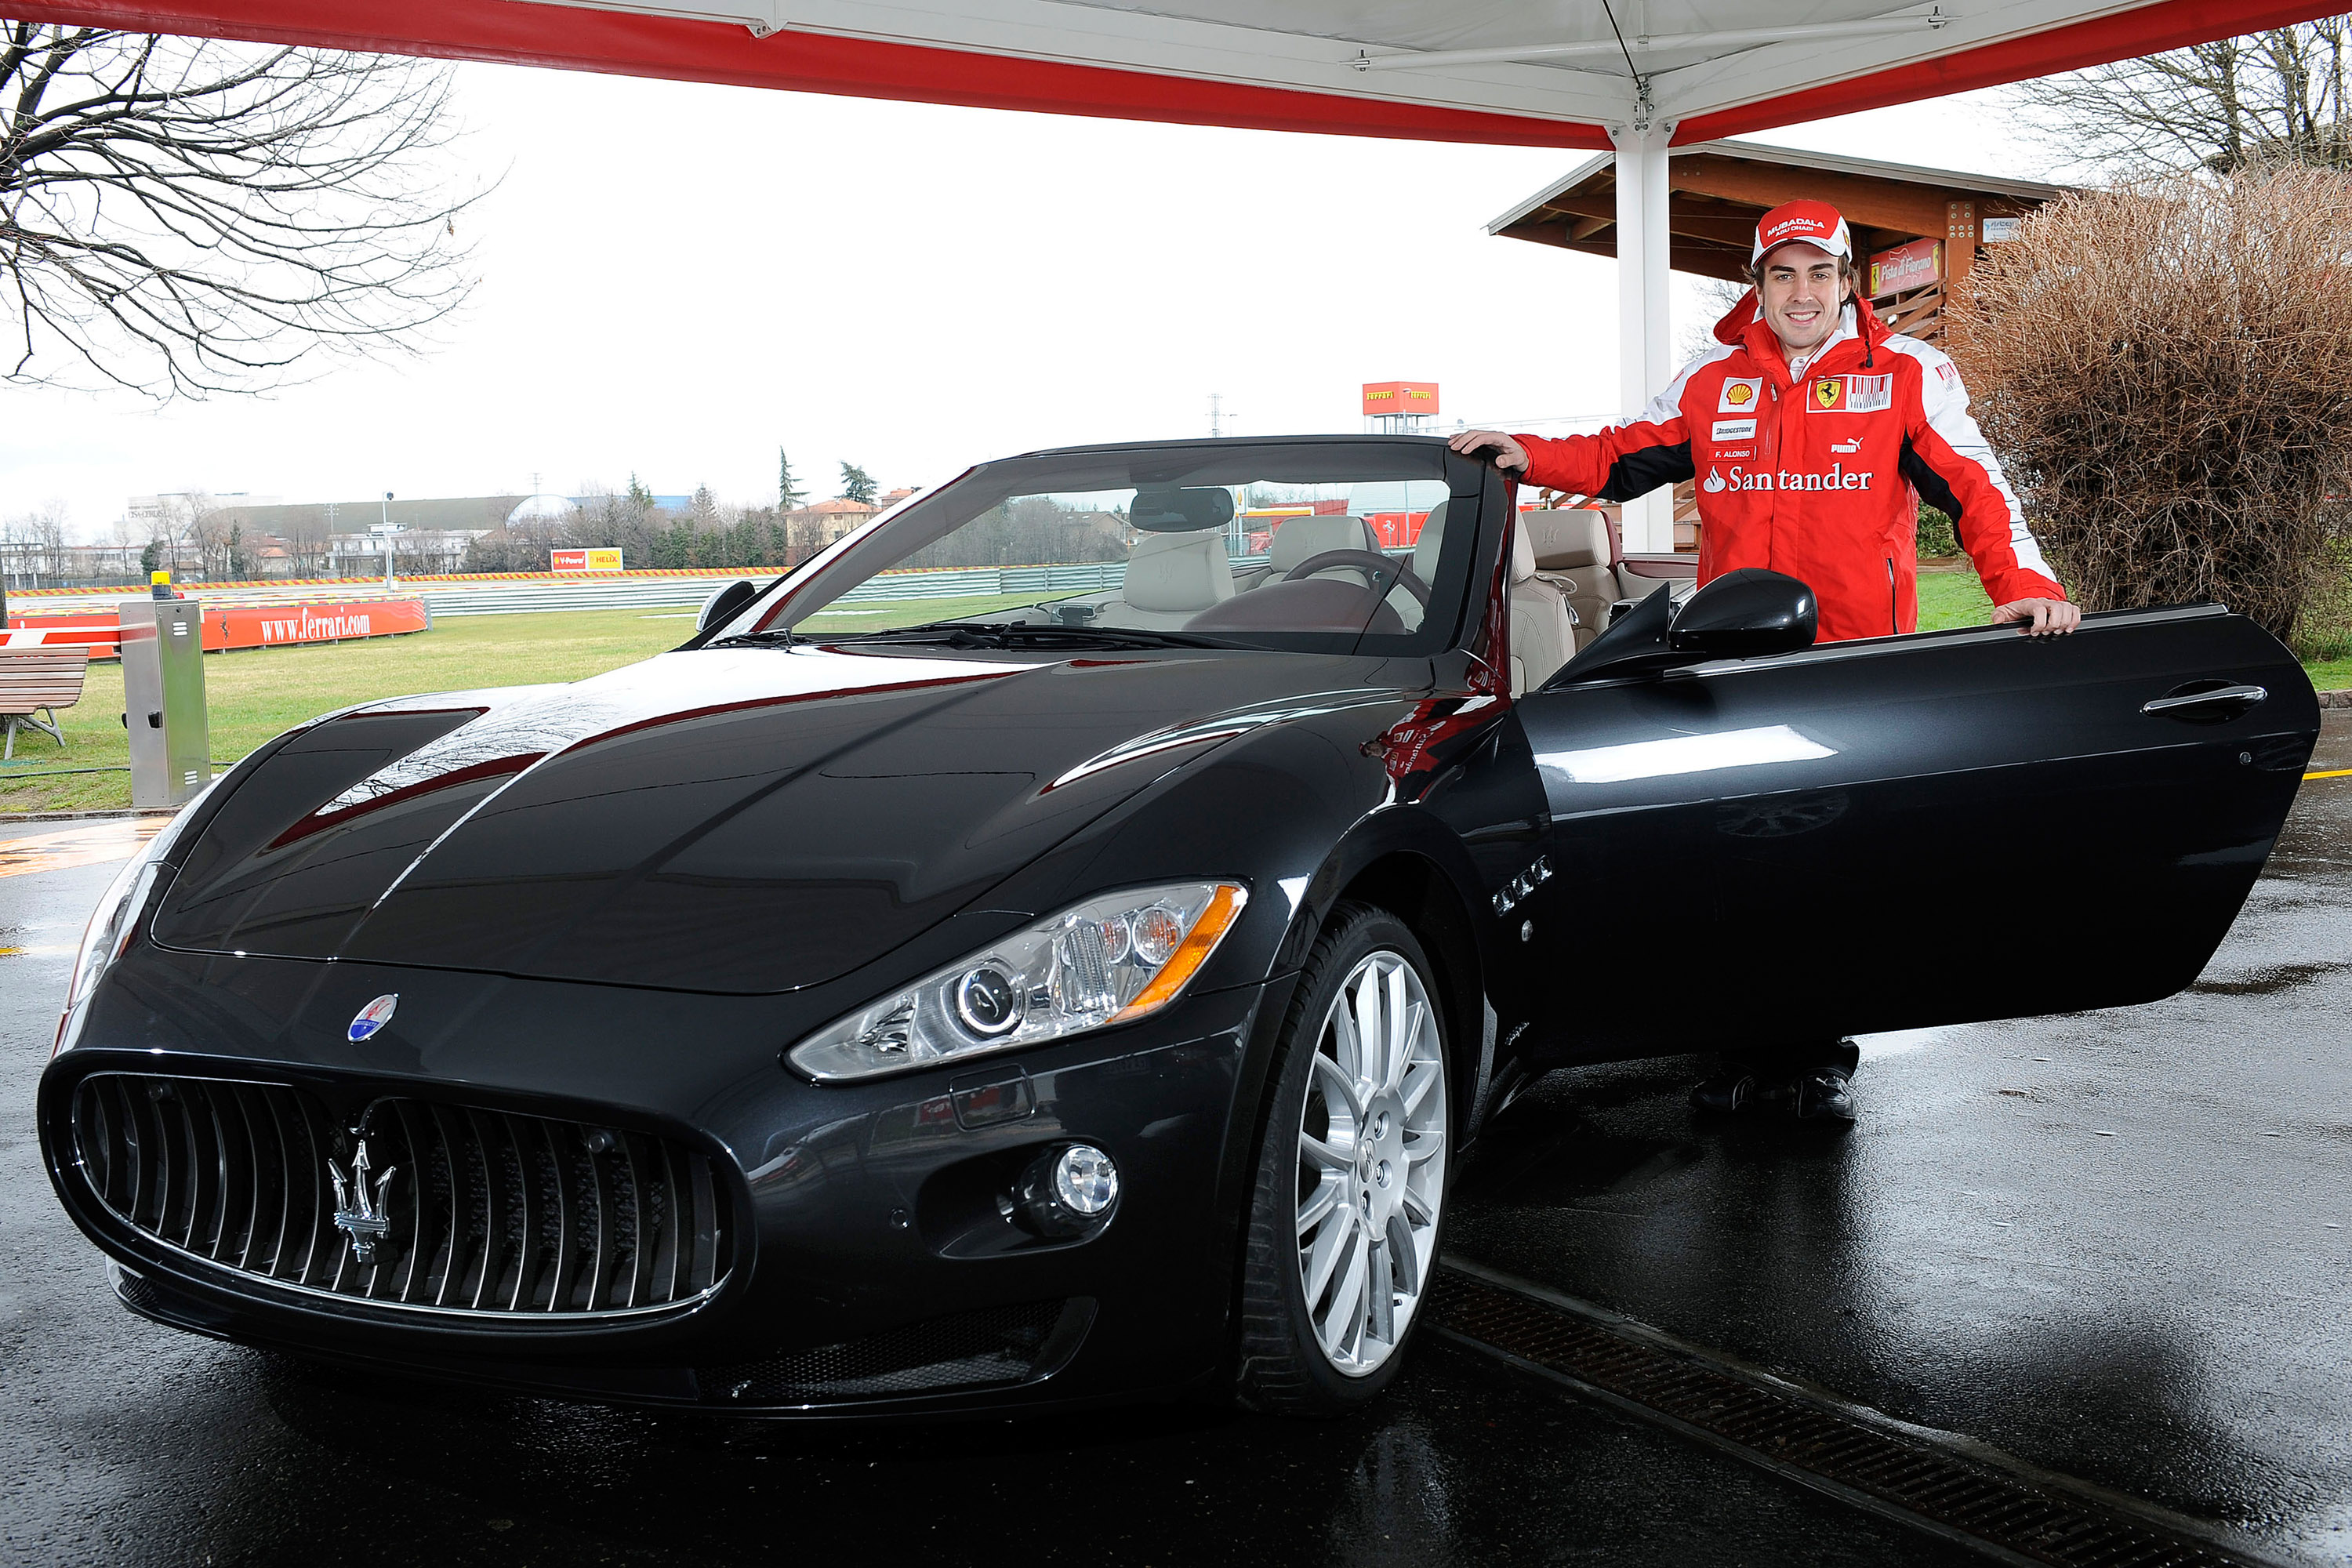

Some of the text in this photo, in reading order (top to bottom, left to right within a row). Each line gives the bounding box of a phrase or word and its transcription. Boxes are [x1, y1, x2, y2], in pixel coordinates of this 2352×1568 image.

[1767, 218, 1825, 237] MUBADALA
[1775, 227, 1791, 237] ABU
[1882, 256, 1932, 281] Pista di Fiorano
[1367, 391, 1393, 401] Ferrari
[1715, 426, 1753, 434] BRIDGESTONE
[1831, 444, 1857, 452] PUMA
[1728, 463, 1873, 492] Santander
[560, 555, 585, 564] V-Power
[596, 554, 618, 563] HELIX
[260, 606, 371, 641] www.ferrari.com
